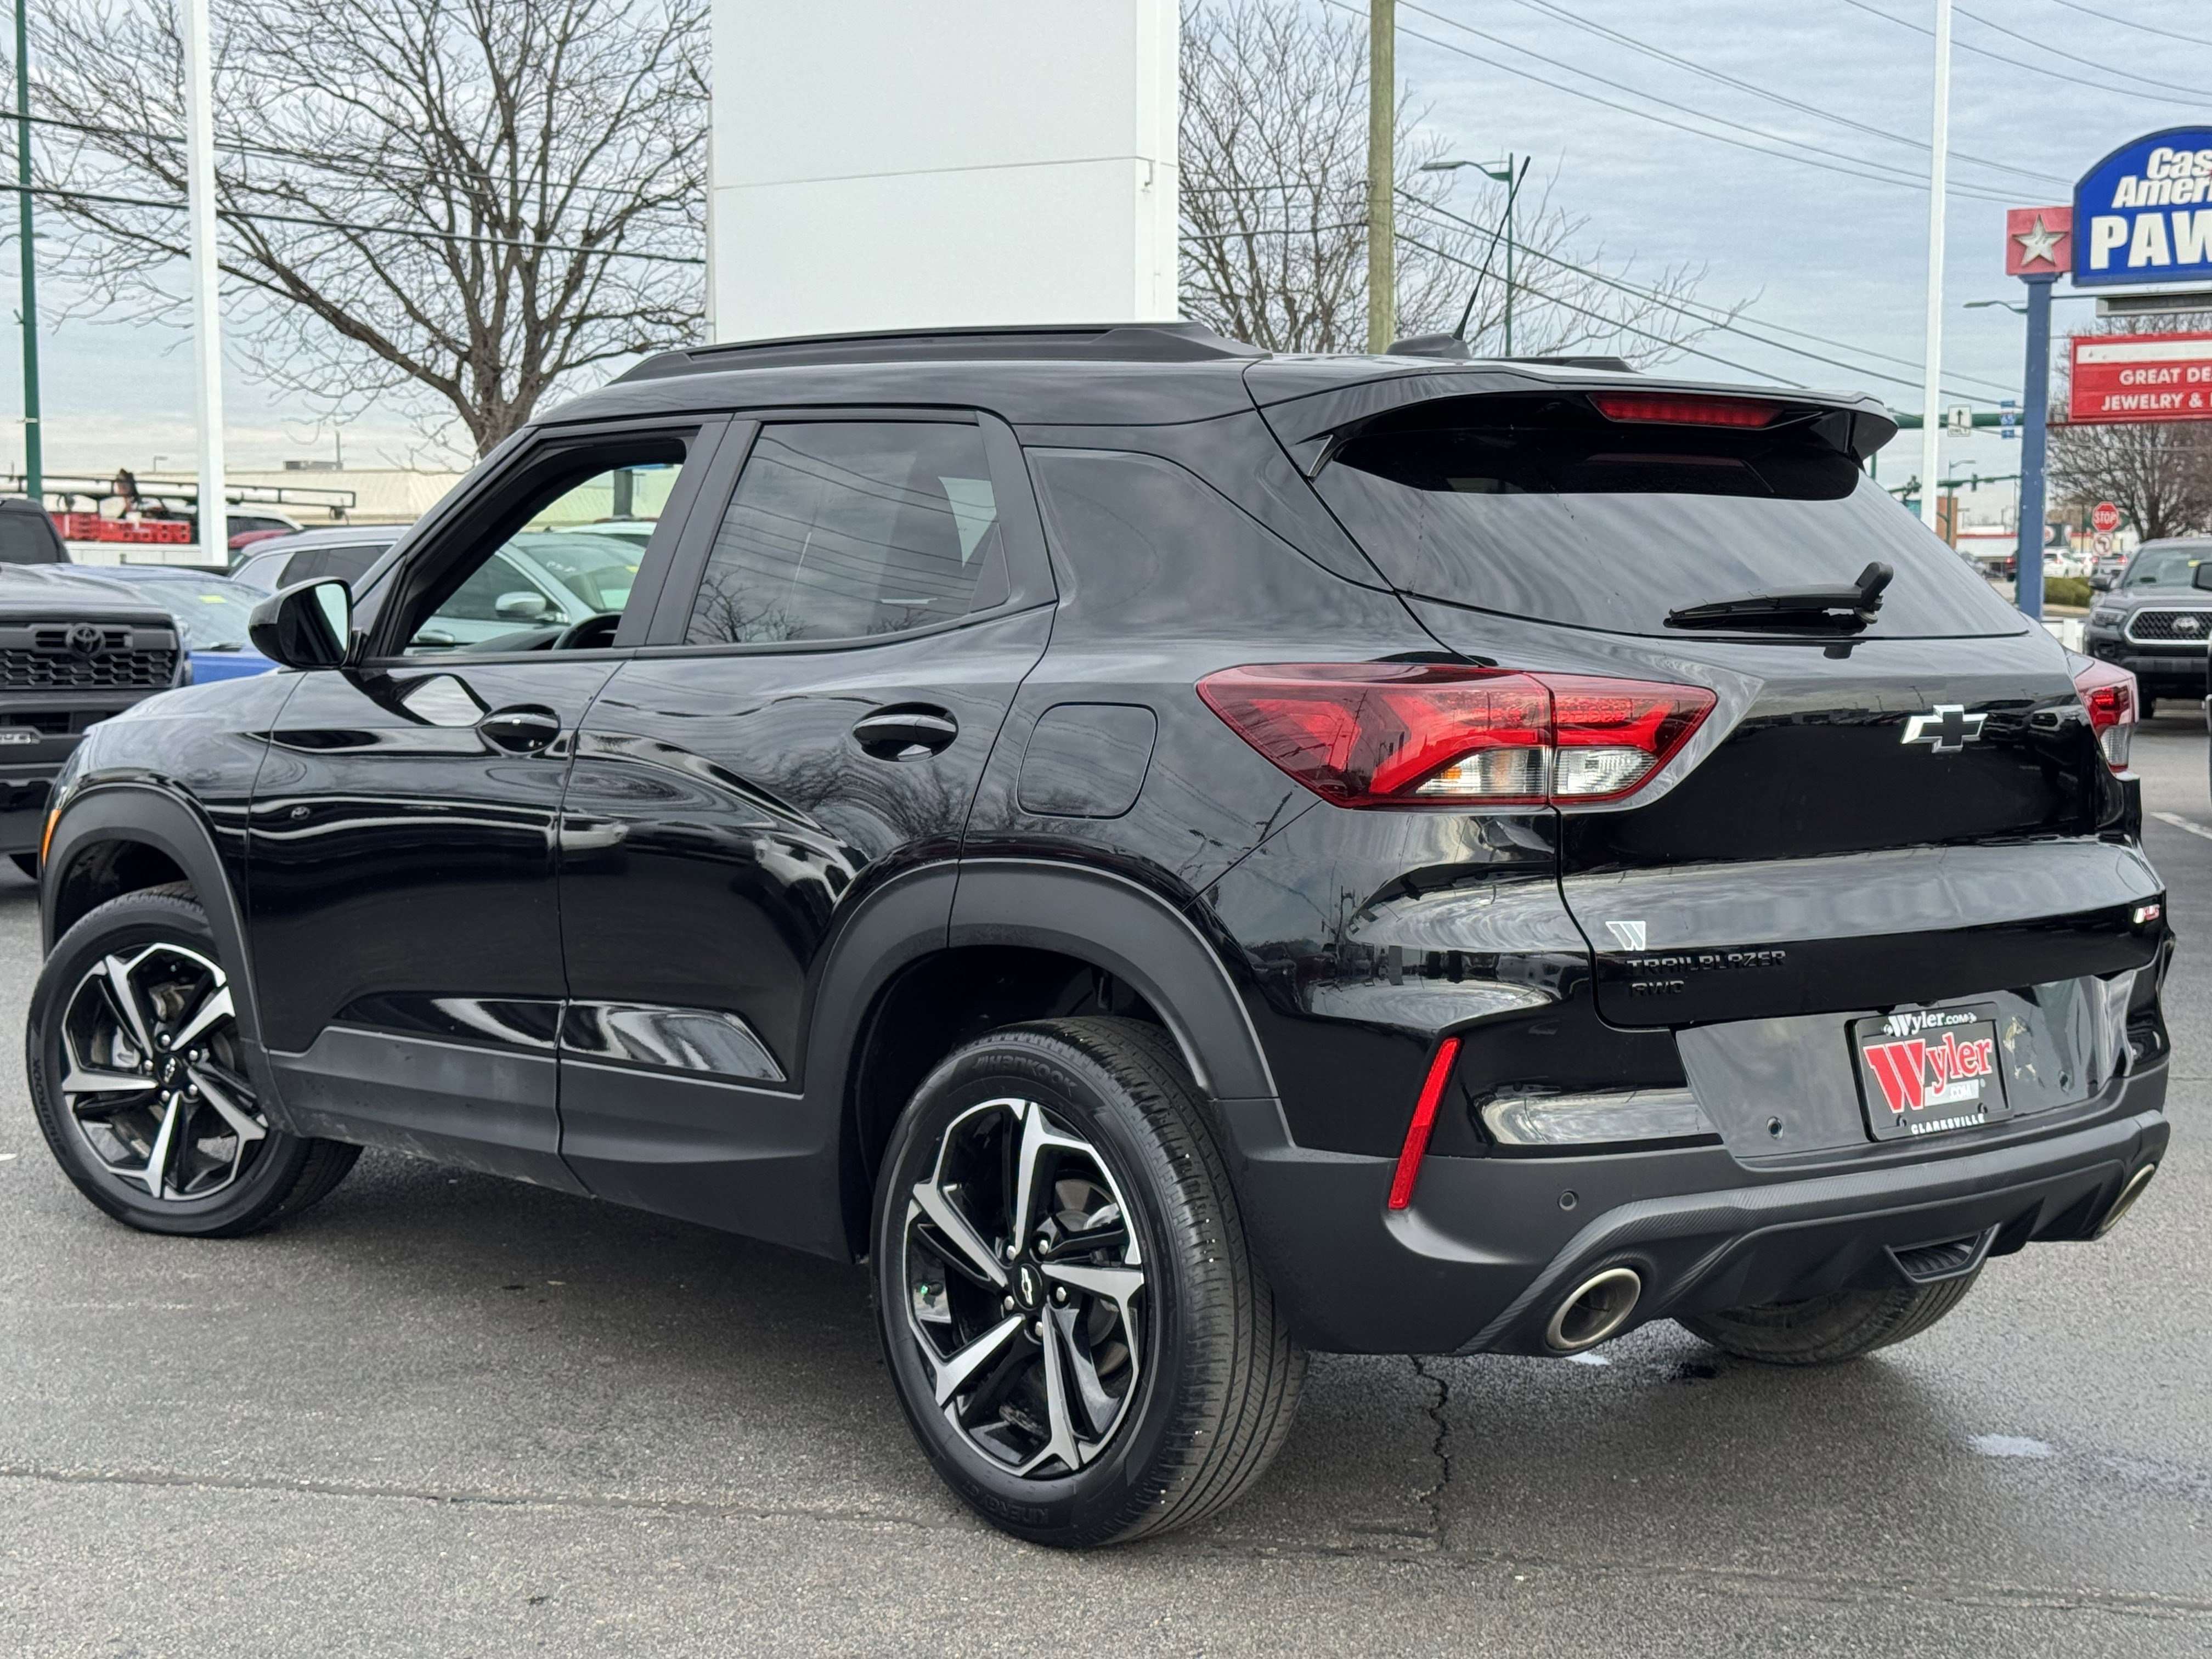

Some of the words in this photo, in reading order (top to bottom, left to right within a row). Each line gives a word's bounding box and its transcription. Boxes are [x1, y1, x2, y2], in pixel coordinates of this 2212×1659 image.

[2119, 367, 2180, 386] GREAT
[2186, 366, 2212, 383] DE
[2101, 392, 2184, 411] JEWELRY
[2188, 392, 2203, 408] &
[2094, 511, 2117, 524] STOP
[1626, 950, 1786, 975] TRAILBLAZER
[1863, 1031, 1993, 1114] Wyler
[1911, 1113, 1985, 1135] CLARKSVILLE
